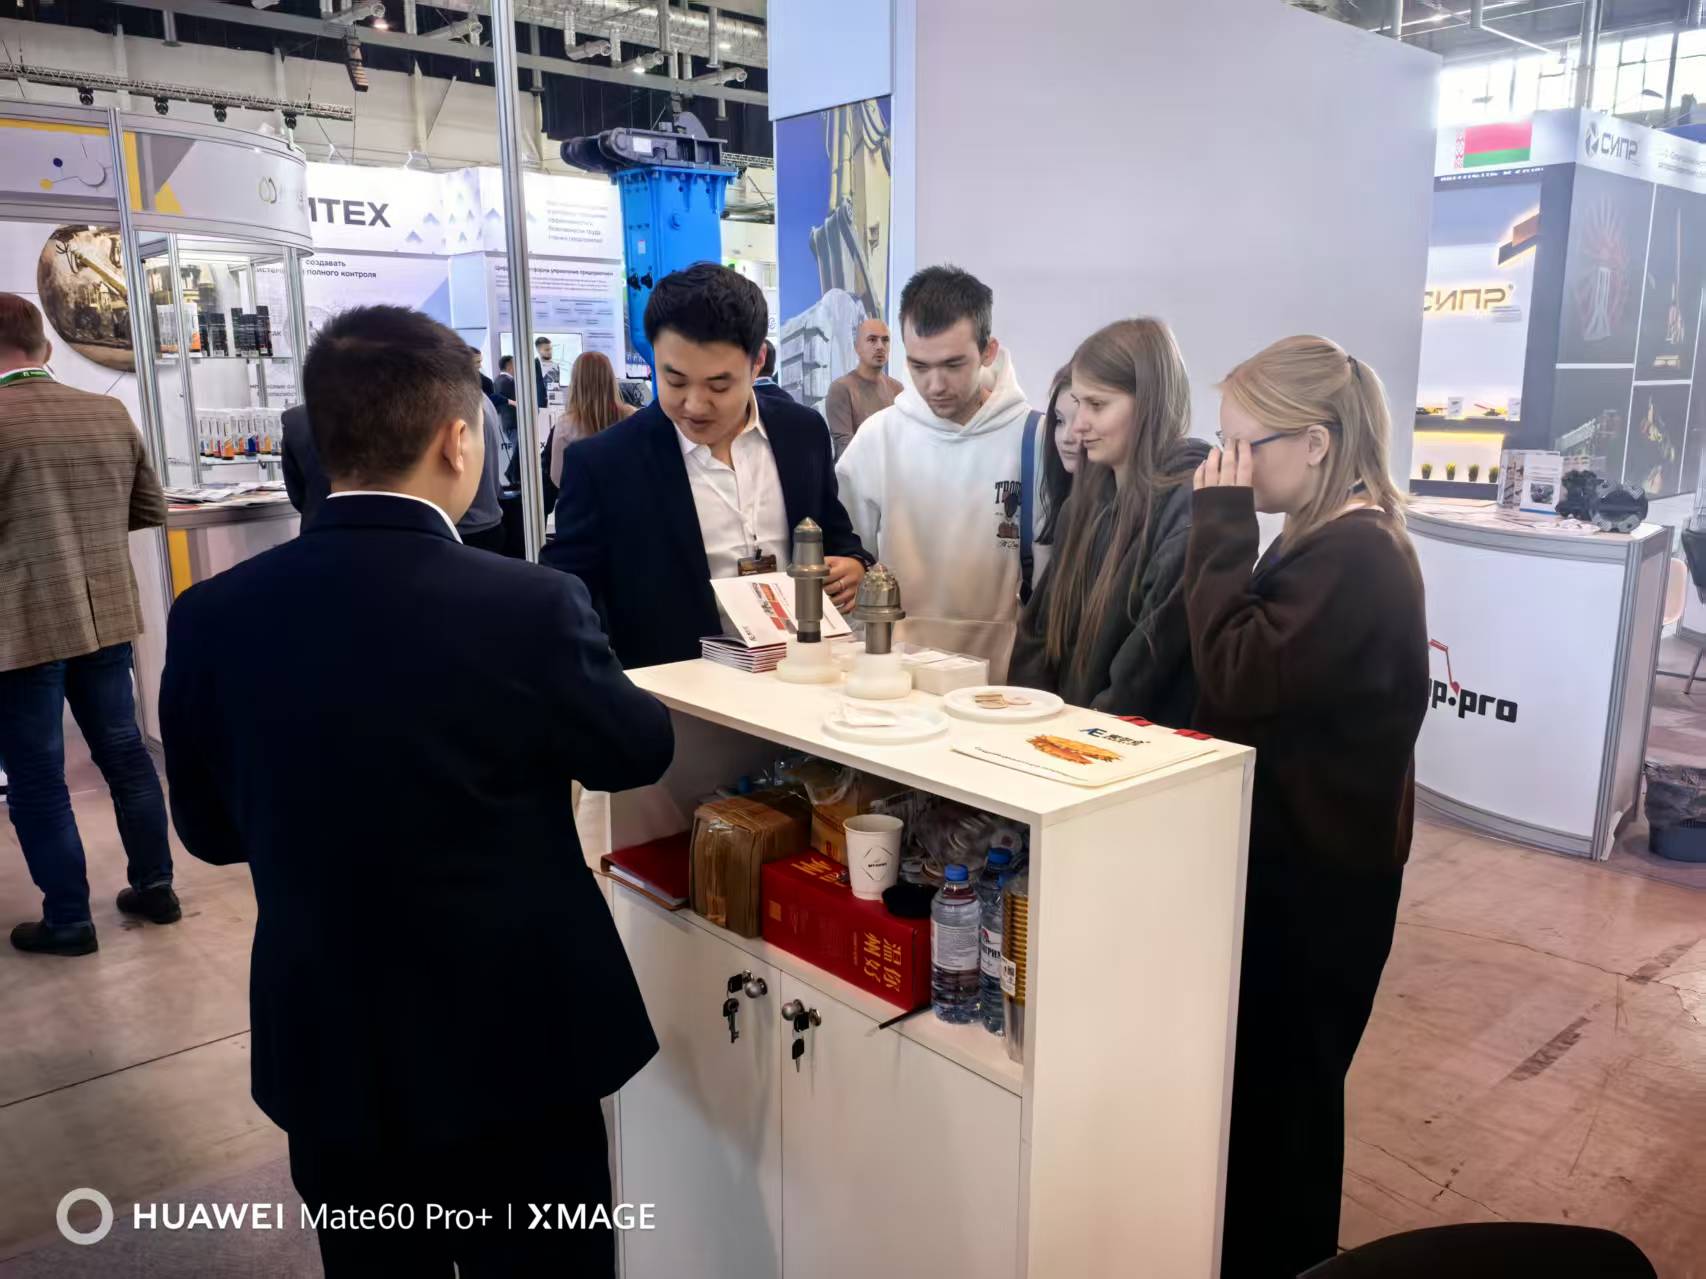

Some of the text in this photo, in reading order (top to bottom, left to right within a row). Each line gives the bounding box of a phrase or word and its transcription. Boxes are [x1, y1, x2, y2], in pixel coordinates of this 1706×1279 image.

[1601, 132, 1639, 161] СИПР
[305, 259, 346, 267] создавать
[306, 269, 339, 277] полного
[340, 271, 377, 279] контроля
[1423, 287, 1506, 312] СИПР
